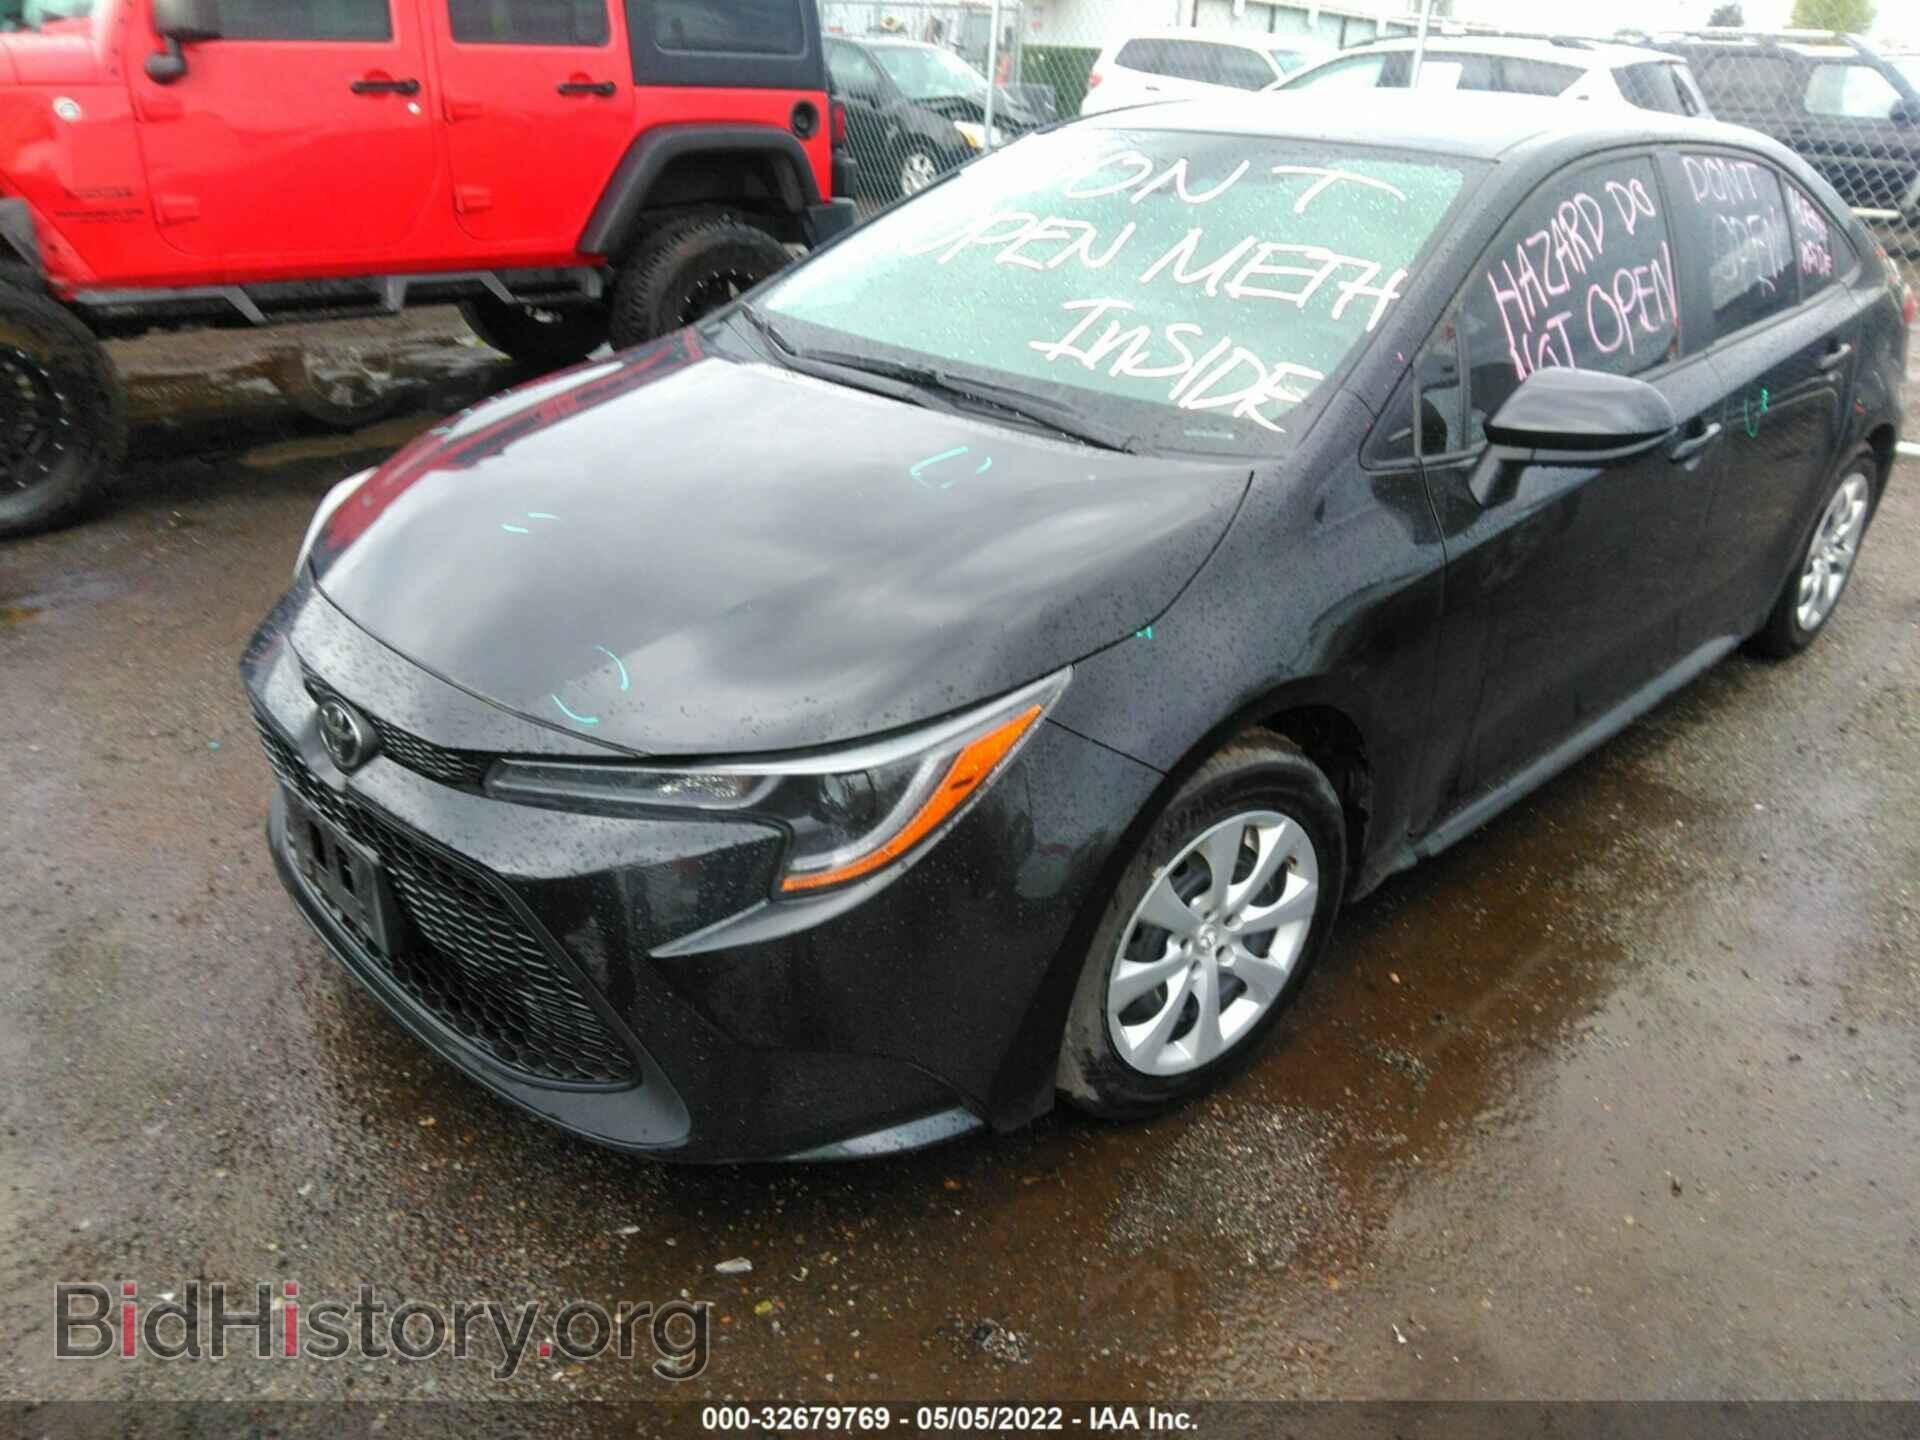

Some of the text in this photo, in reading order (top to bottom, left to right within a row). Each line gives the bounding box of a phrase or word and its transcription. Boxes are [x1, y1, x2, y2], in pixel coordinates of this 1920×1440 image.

[1139, 228, 1408, 333] METH
[1487, 178, 1656, 350] HAZARD DO
[1587, 240, 1681, 355] OPEN
